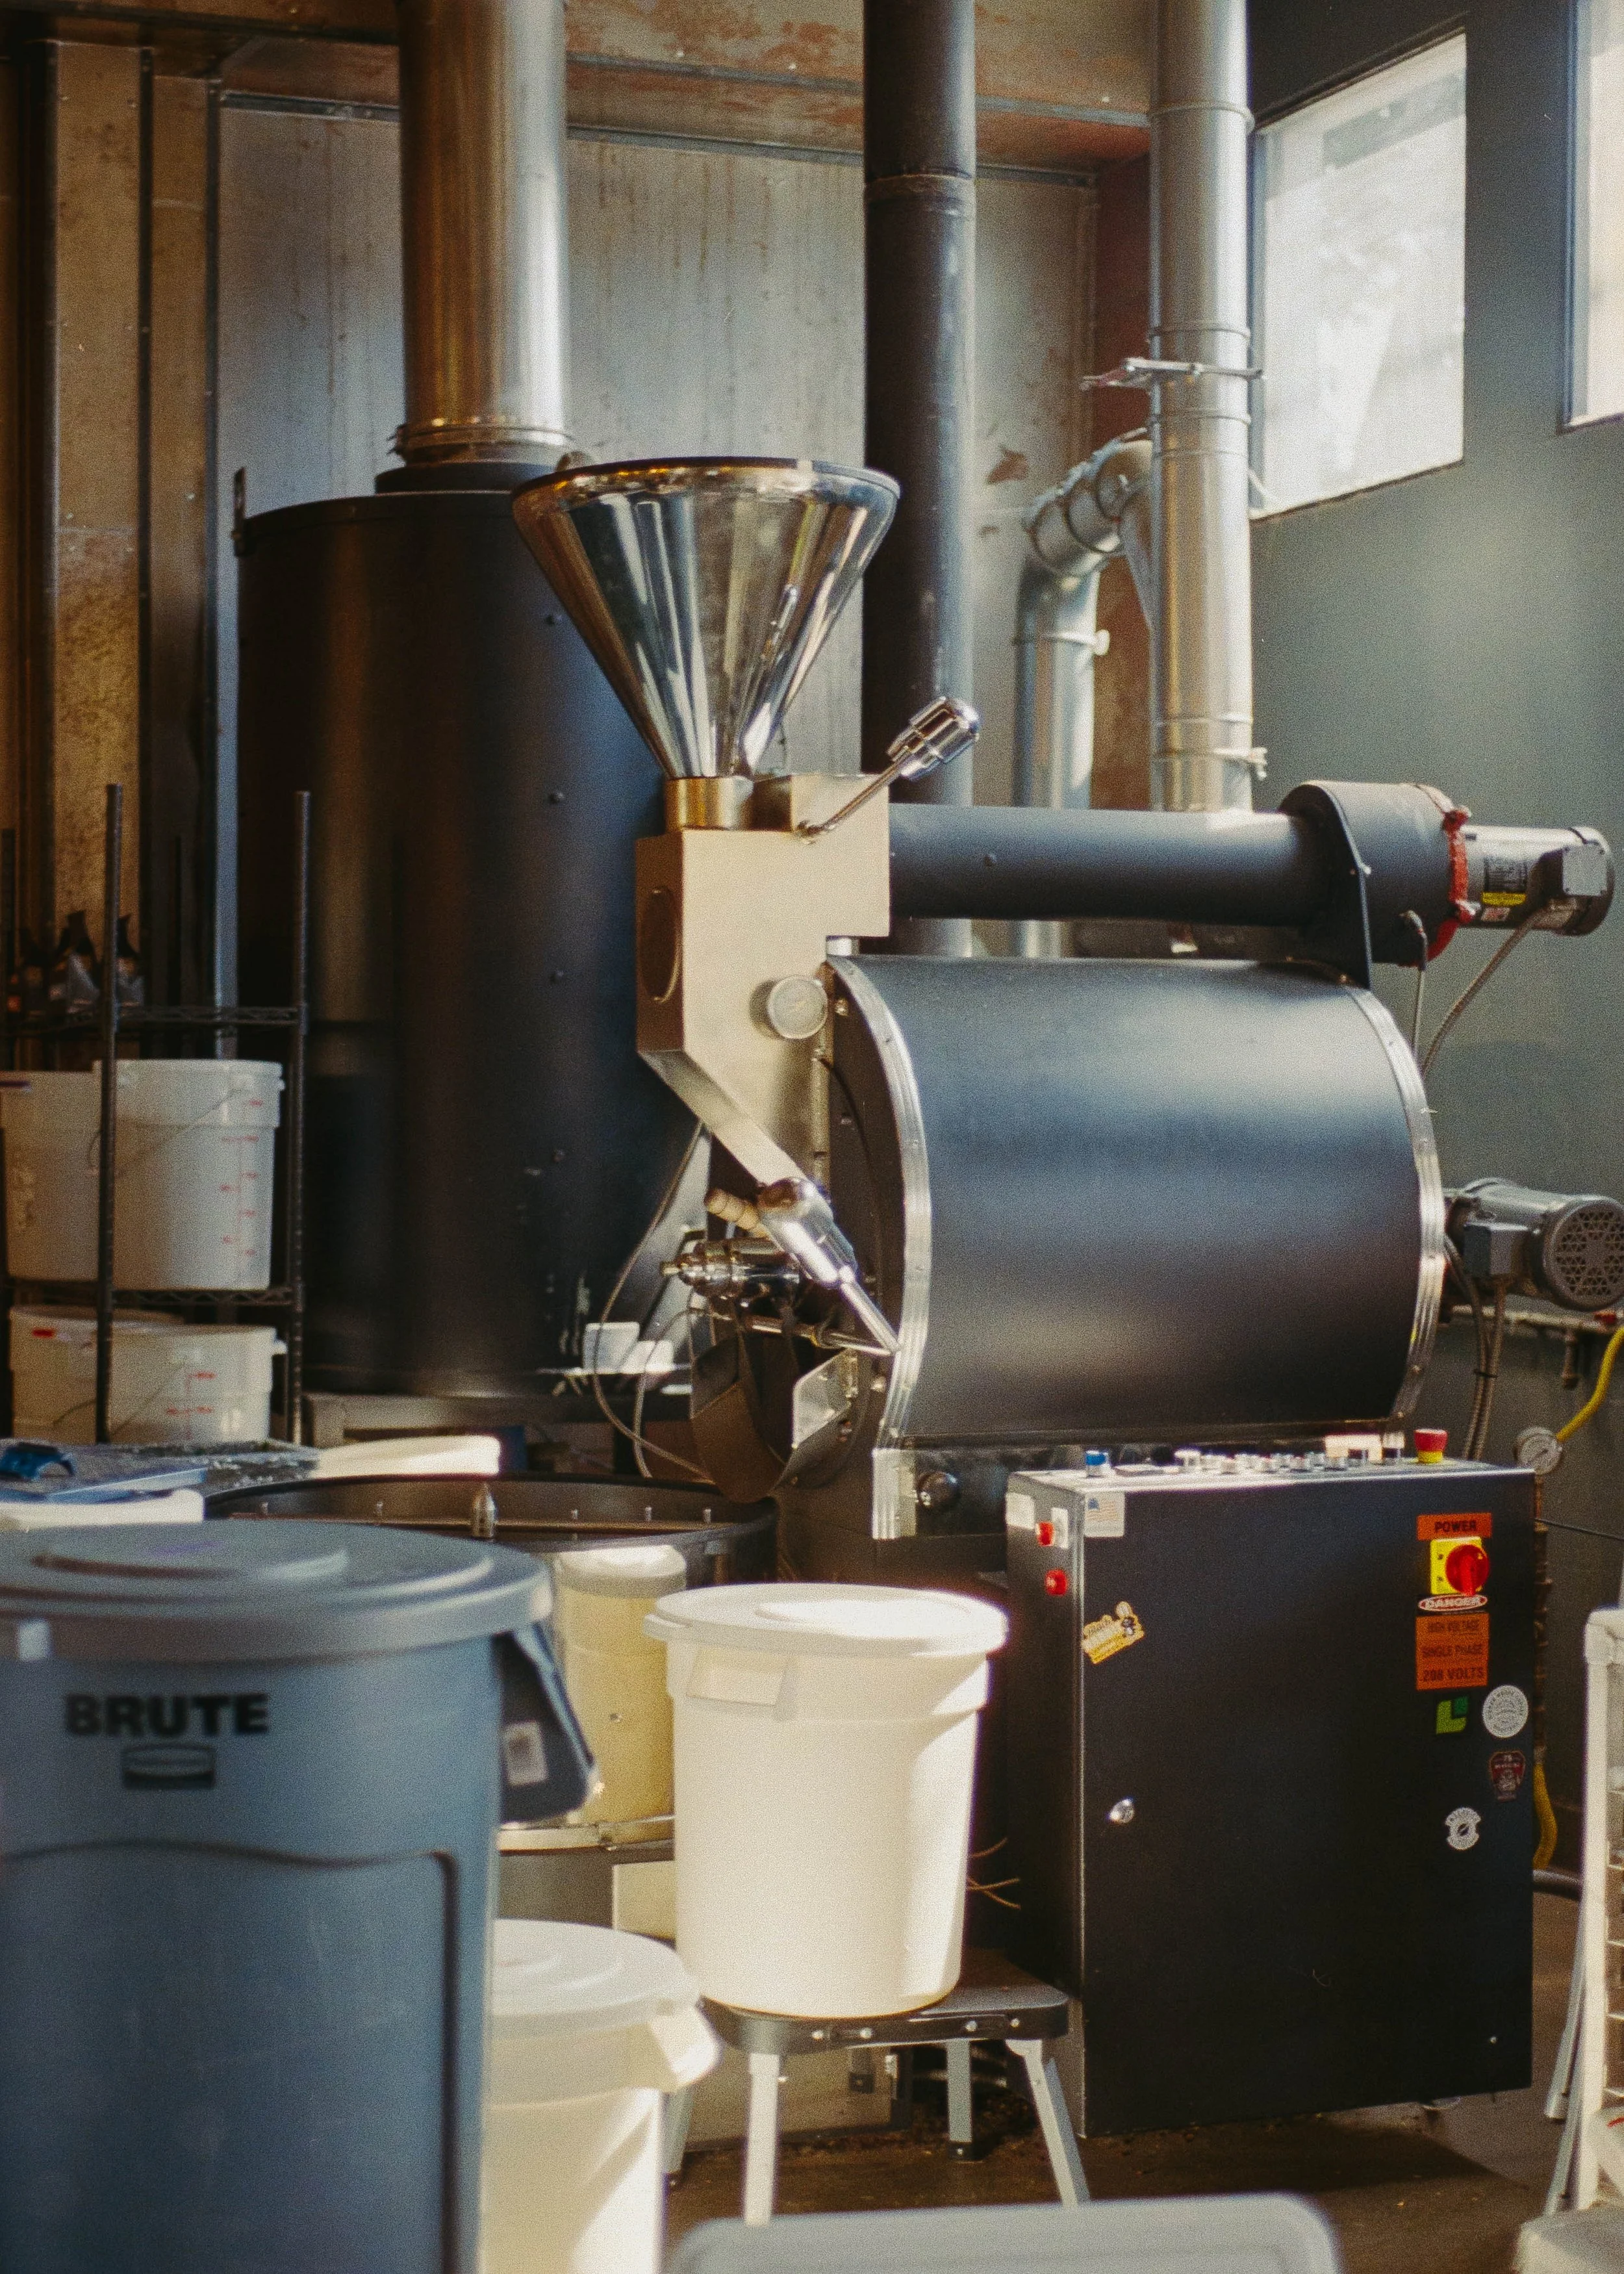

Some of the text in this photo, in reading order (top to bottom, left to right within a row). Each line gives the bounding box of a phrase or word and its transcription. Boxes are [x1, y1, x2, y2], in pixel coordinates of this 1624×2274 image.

[1434, 1520, 1477, 1533] POWER
[1425, 1596, 1481, 1609] DANGER
[1422, 1644, 1483, 1658] SINGLE PHASE
[1447, 1667, 1484, 1680] VOLTS
[67, 1693, 268, 1735] BRUTE
